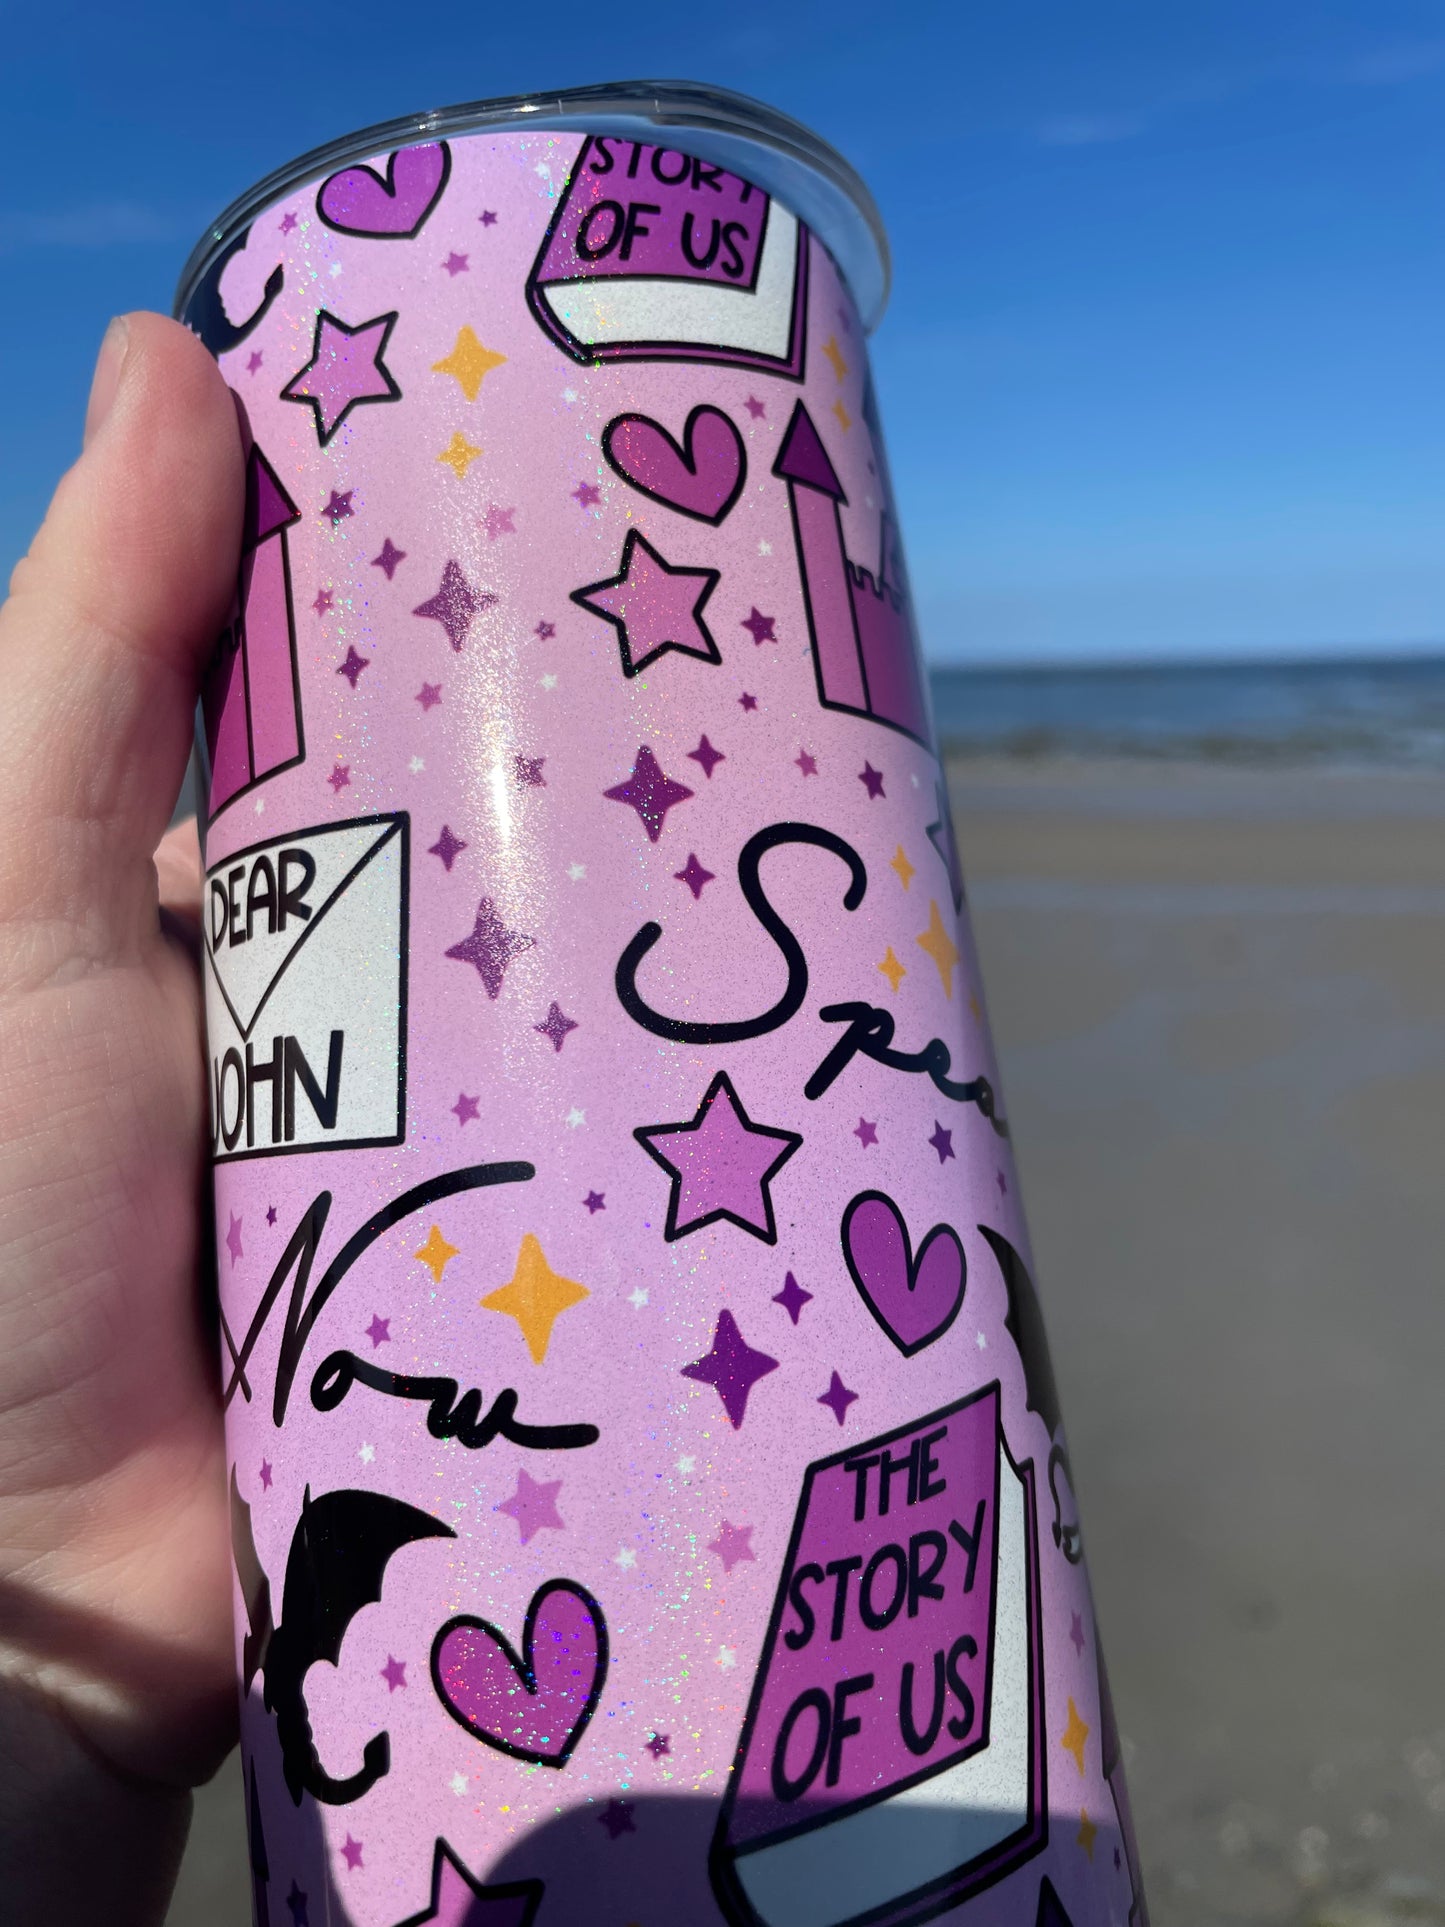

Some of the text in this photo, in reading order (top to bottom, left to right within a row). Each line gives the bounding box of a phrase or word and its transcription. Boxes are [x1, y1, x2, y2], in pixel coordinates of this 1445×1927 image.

[575, 200, 749, 278] OF US
[211, 848, 316, 954] DEAR
[212, 1029, 344, 1156] JOHN
[220, 1161, 600, 1449] Now
[844, 1426, 949, 1521] THE
[784, 1500, 986, 1650] STORY
[771, 1634, 978, 1800] OF US
